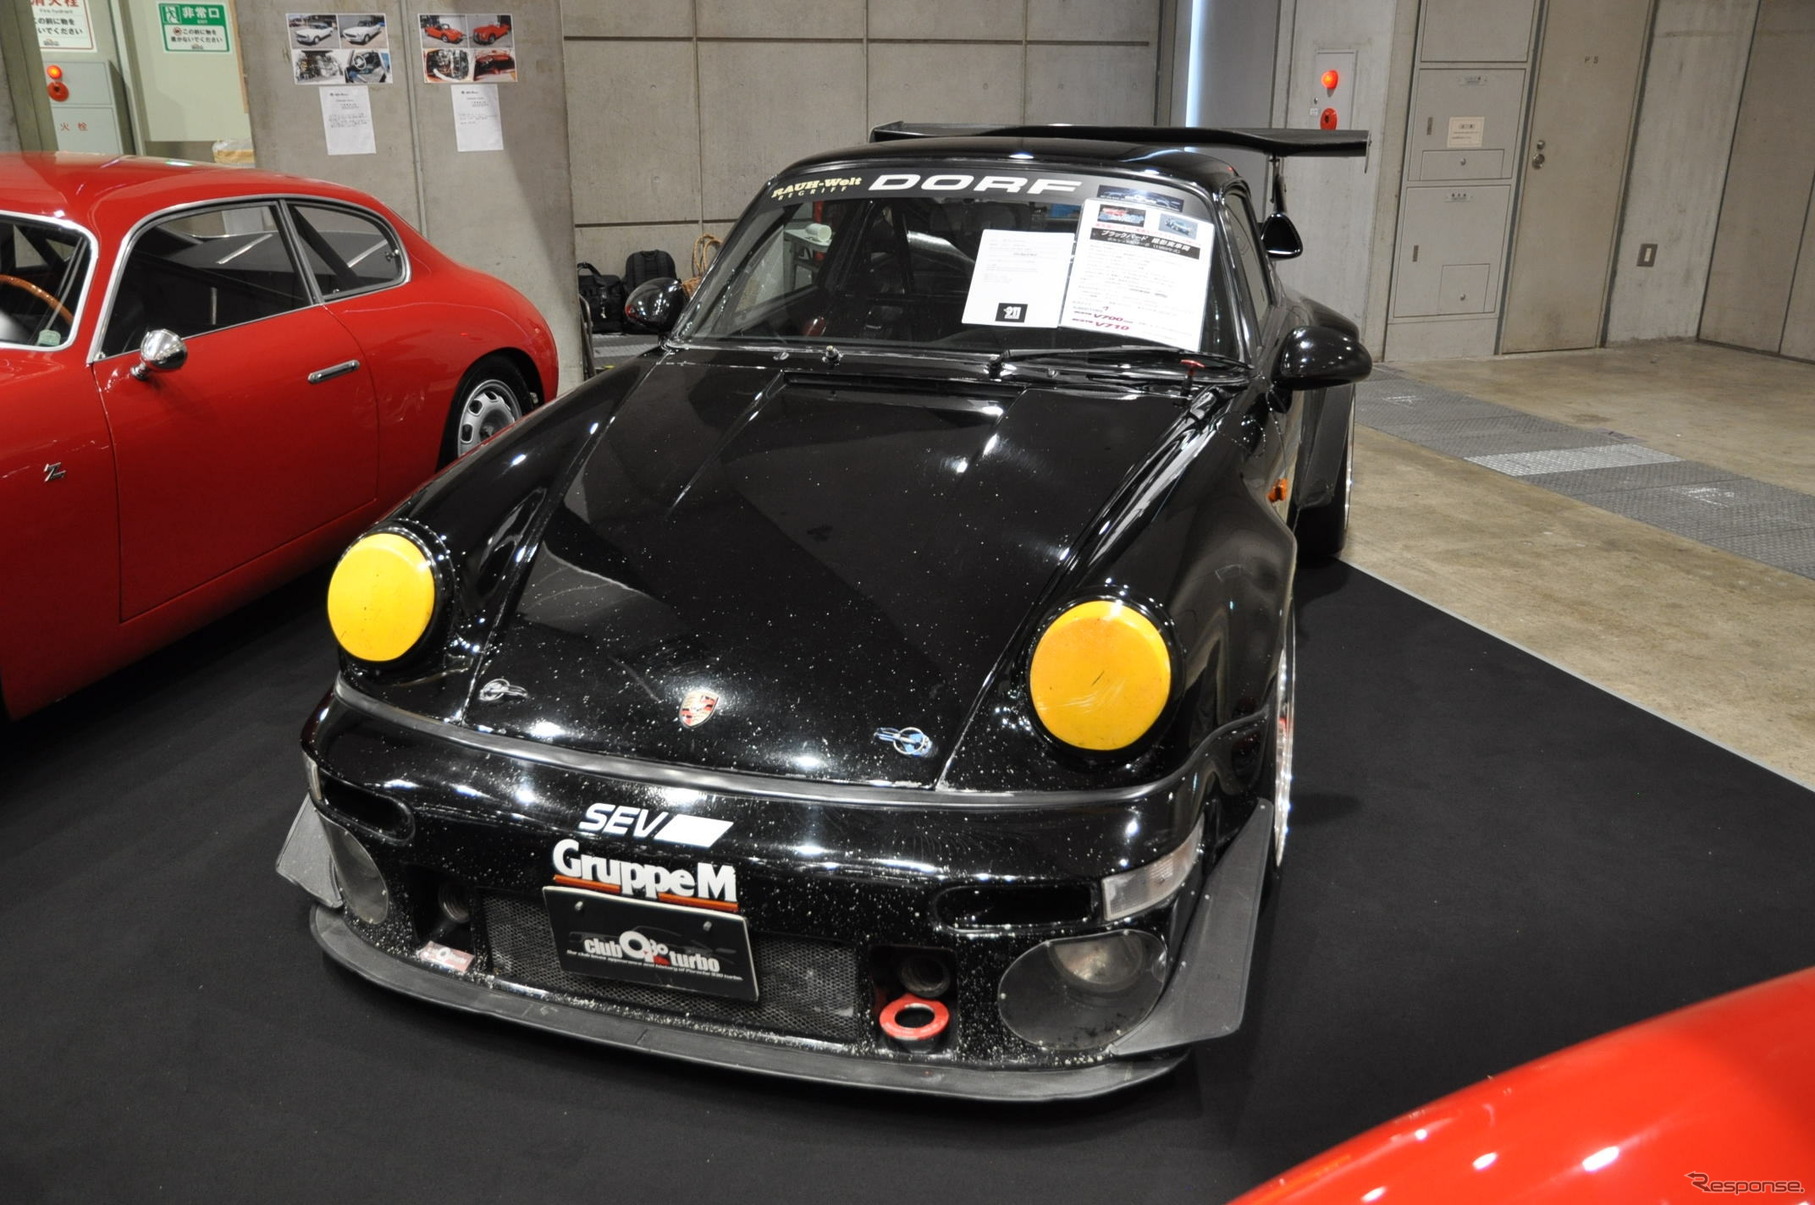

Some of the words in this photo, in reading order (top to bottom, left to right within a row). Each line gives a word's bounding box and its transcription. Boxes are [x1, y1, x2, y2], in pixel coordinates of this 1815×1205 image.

[182, 6, 220, 18] 非常口
[771, 177, 862, 198] RAUH-Welt
[868, 174, 1082, 195] DORF
[578, 802, 669, 838] SEV
[552, 838, 738, 902] GruppeM
[583, 937, 623, 959] club
[669, 951, 720, 973] turbo
